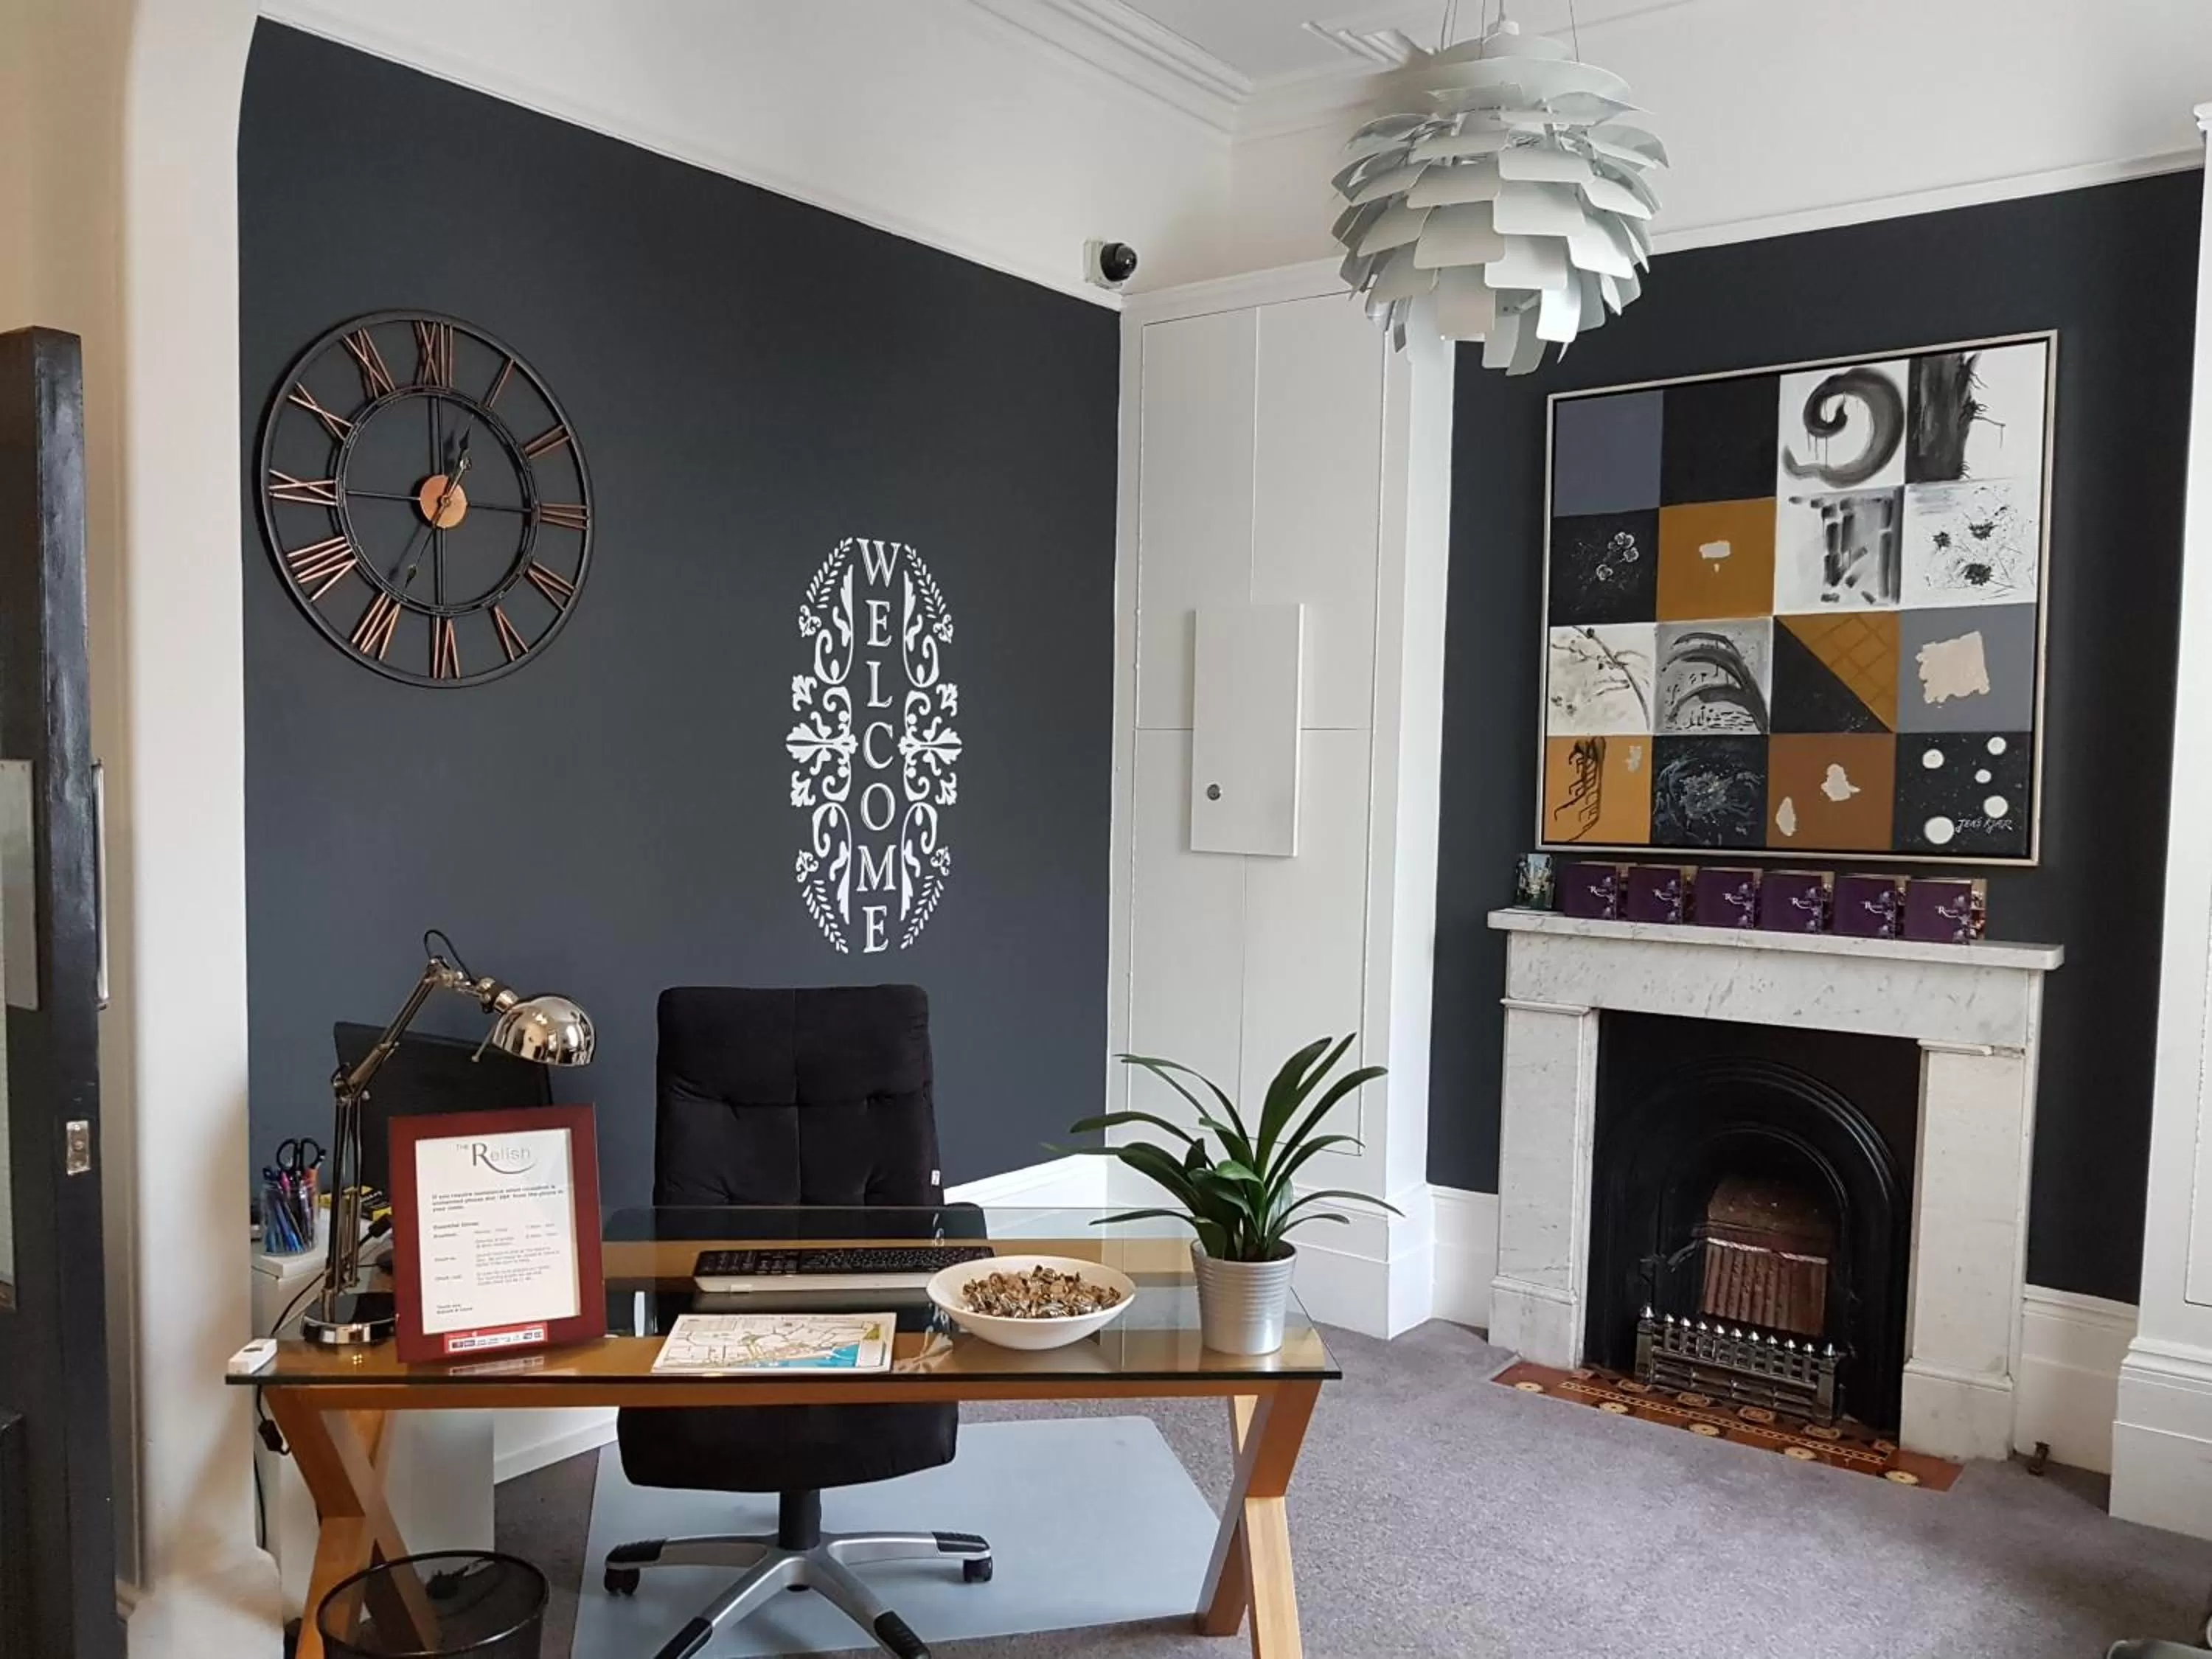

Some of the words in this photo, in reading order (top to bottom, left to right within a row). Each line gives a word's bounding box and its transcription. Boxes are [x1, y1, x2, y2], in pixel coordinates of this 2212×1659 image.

[342, 327, 396, 398] XI
[420, 319, 454, 391] XII
[484, 358, 516, 408] I
[288, 381, 354, 442] X
[523, 424, 572, 459] II
[268, 469, 339, 505] IX
[540, 503, 589, 530] III
[287, 536, 358, 602] VIII
[528, 562, 577, 612] IV
[352, 592, 401, 661] VII
[433, 617, 461, 679] VI
[493, 605, 529, 662] V
[856, 538, 901, 953] WELCOME
[456, 1143, 468, 1151] THE
[472, 1142, 535, 1174] Relish
